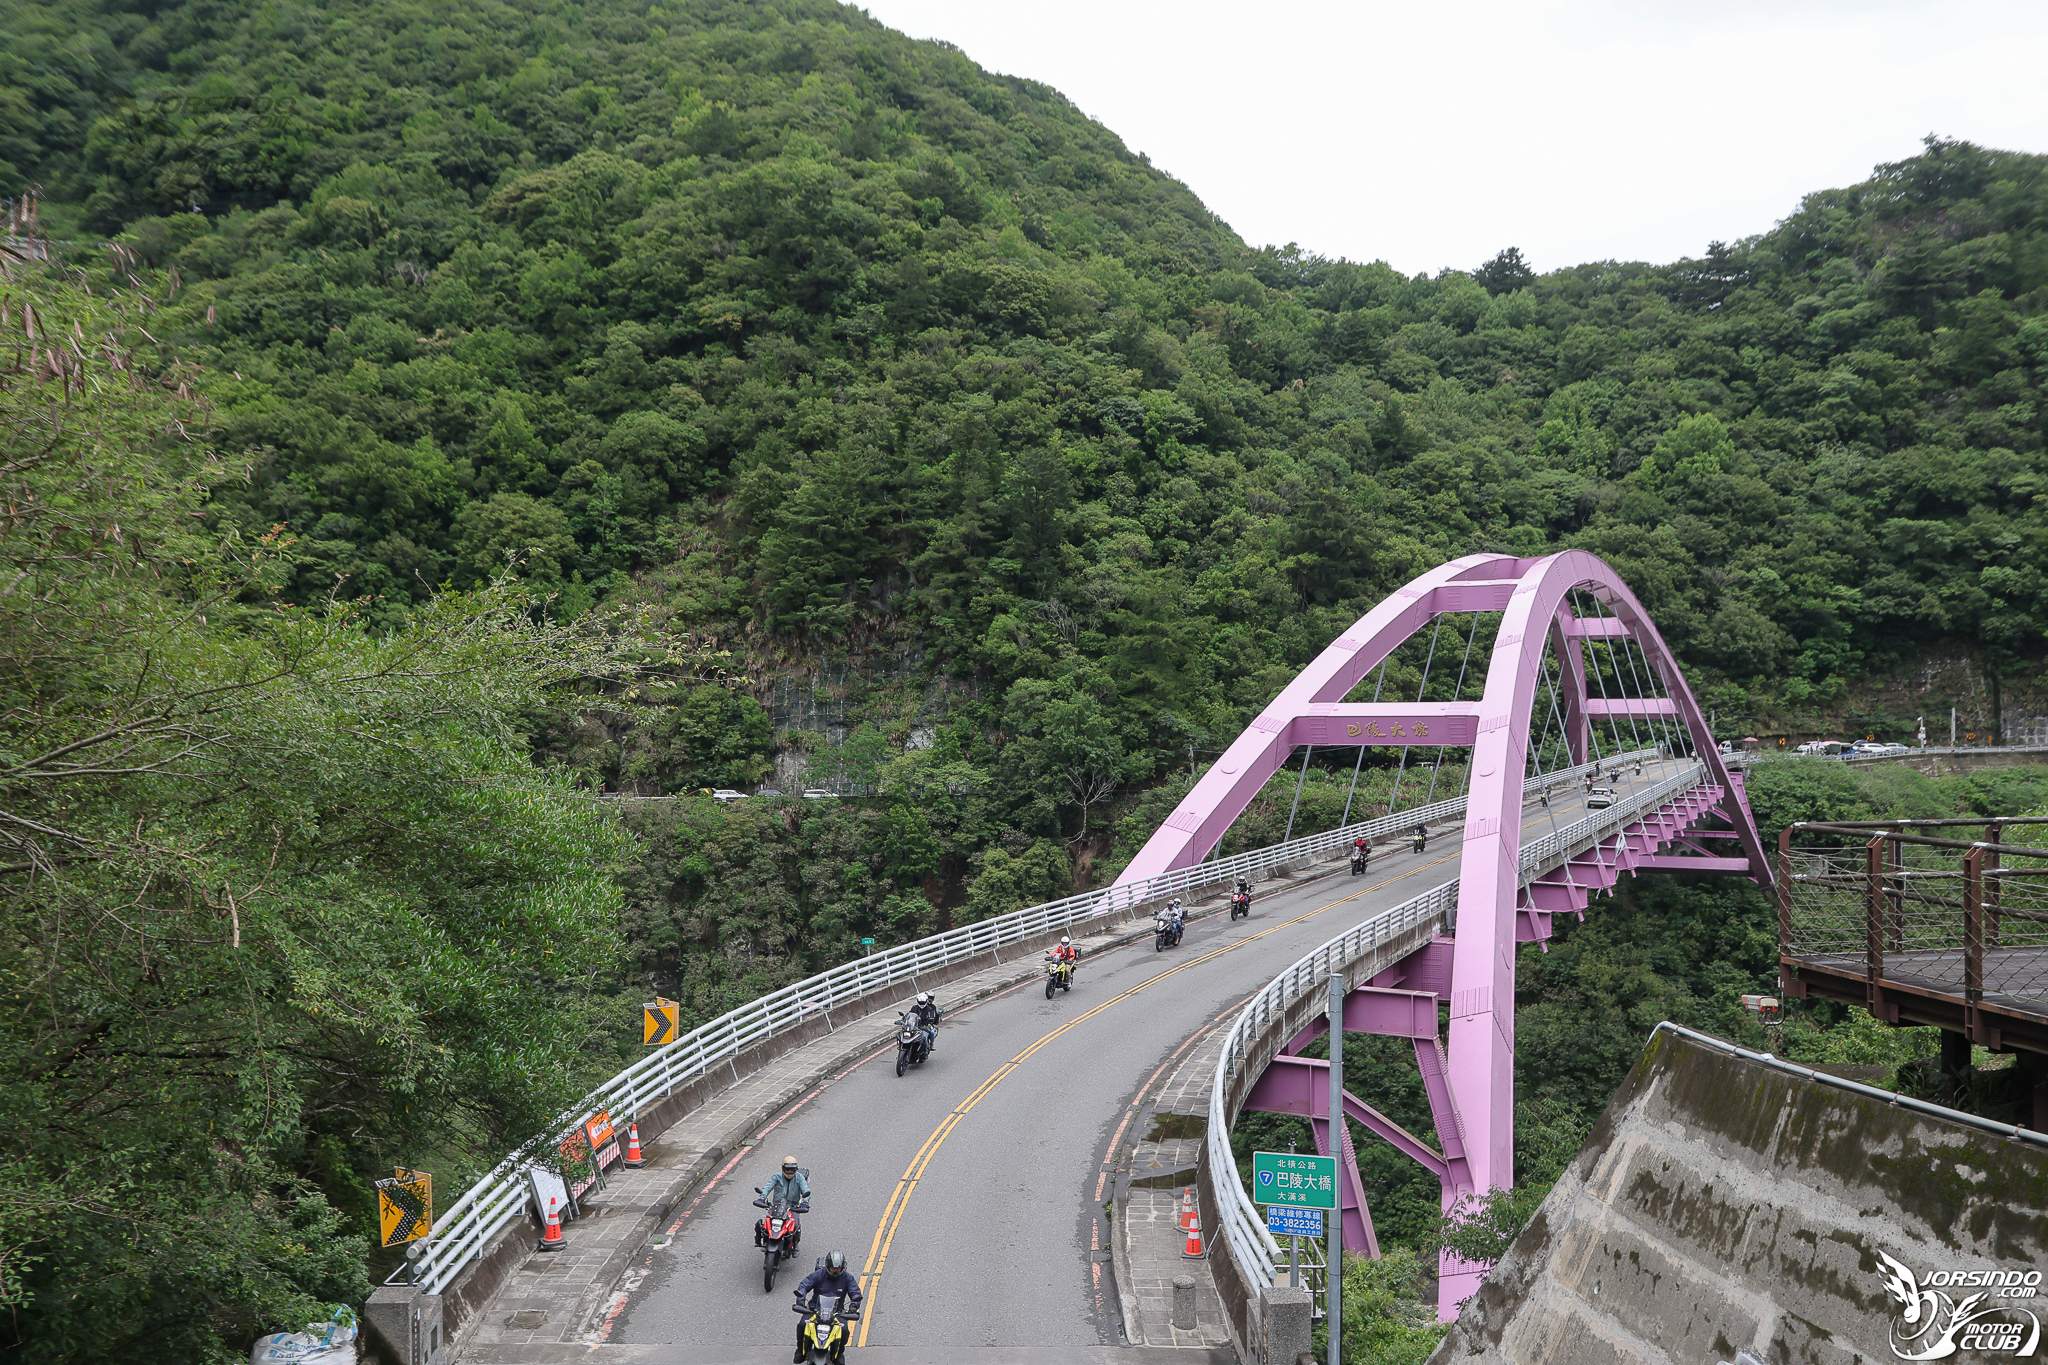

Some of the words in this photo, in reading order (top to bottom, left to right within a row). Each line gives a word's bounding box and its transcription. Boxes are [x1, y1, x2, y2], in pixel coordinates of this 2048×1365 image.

[1277, 1159, 1317, 1170] 北橫公路
[1262, 1173, 1270, 1182] 7
[1277, 1171, 1332, 1191] 巴陵大橋
[1277, 1191, 1307, 1202] 大漢溪
[1269, 1216, 1321, 1230] 03-3822356
